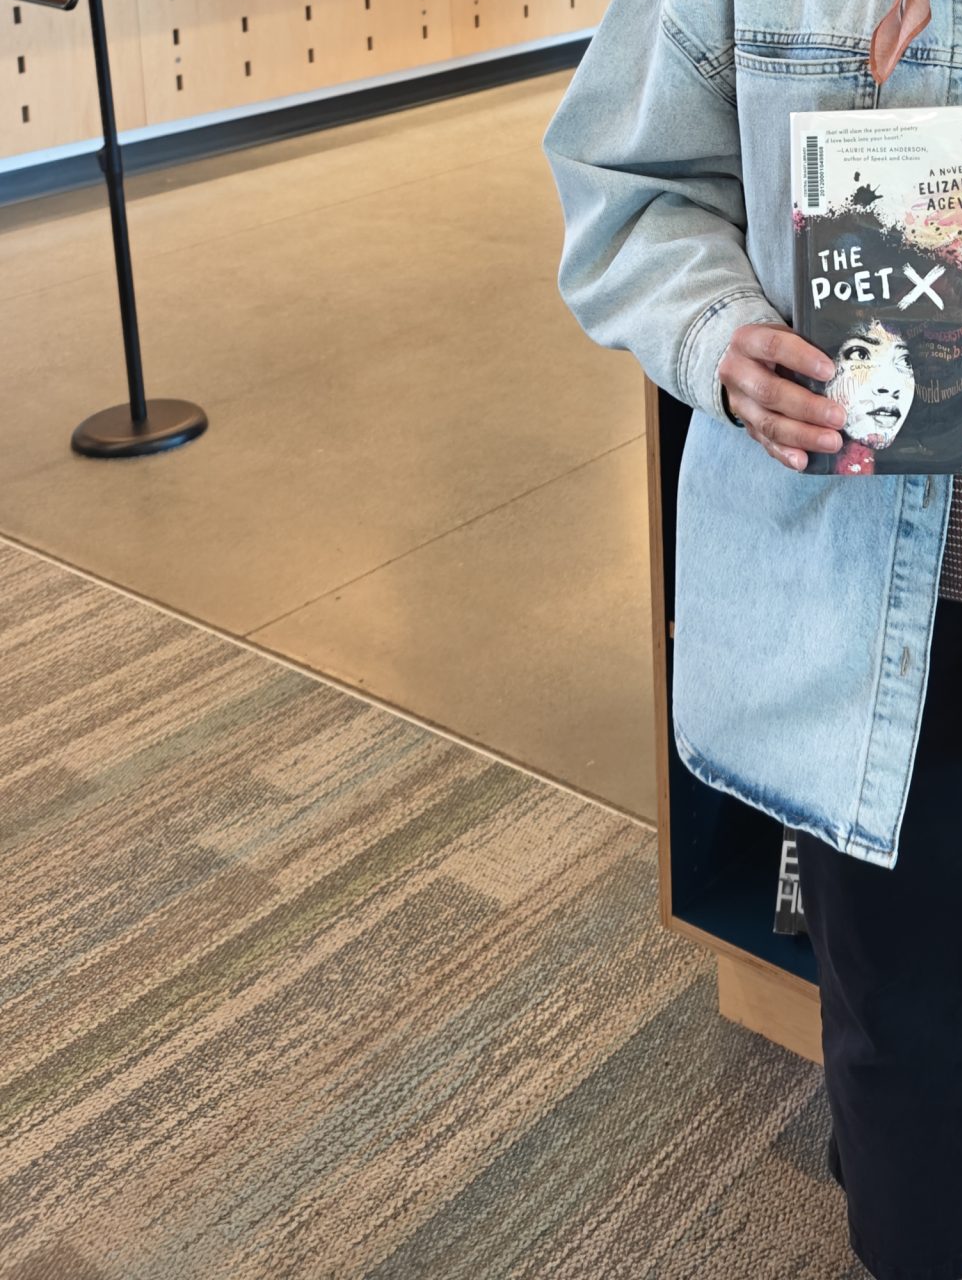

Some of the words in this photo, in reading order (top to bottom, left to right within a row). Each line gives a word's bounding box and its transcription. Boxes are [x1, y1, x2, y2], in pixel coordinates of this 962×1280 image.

[929, 169, 935, 177] A
[818, 246, 863, 272] THE
[897, 262, 946, 311] X
[931, 351, 952, 362] scalp
[936, 344, 951, 352] out
[915, 379, 940, 403] world
